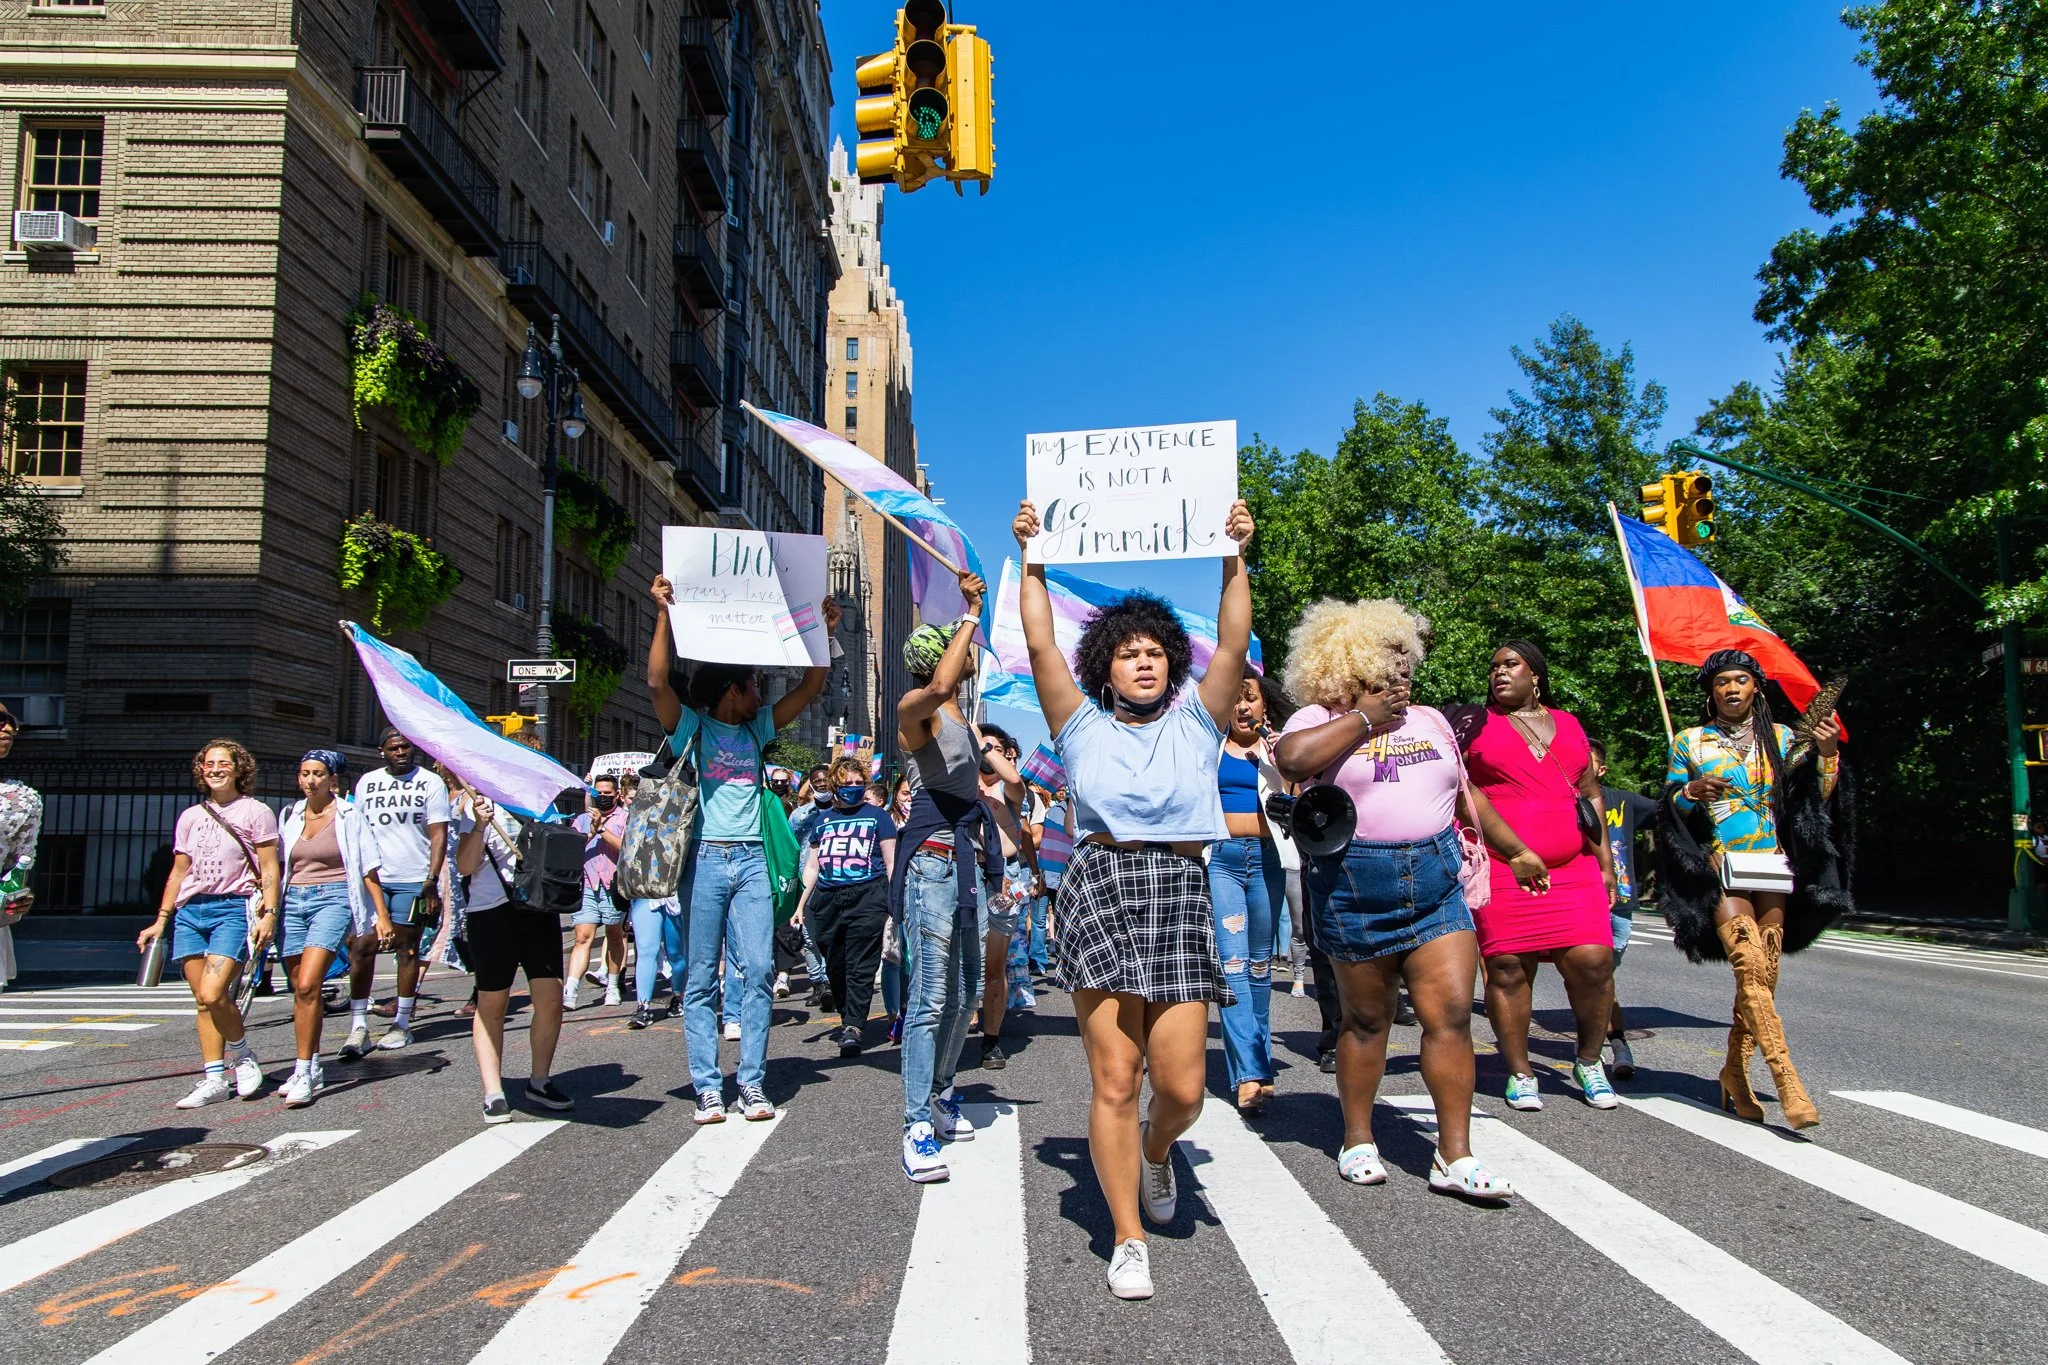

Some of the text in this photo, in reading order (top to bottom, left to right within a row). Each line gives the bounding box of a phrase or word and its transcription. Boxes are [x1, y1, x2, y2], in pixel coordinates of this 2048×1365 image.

[1031, 436, 1079, 466] my
[1108, 467, 1156, 488] NOT
[1162, 467, 1172, 485] A
[672, 574, 732, 603] trans
[708, 611, 768, 625] matter
[518, 666, 565, 675] ONE WAY
[2023, 660, 2032, 673] W
[1353, 729, 1434, 763] HANNAH
[1389, 734, 1415, 744] Disney
[1373, 748, 1443, 783] MONTANA
[366, 780, 428, 794] BLACK
[365, 794, 425, 810] TRANS
